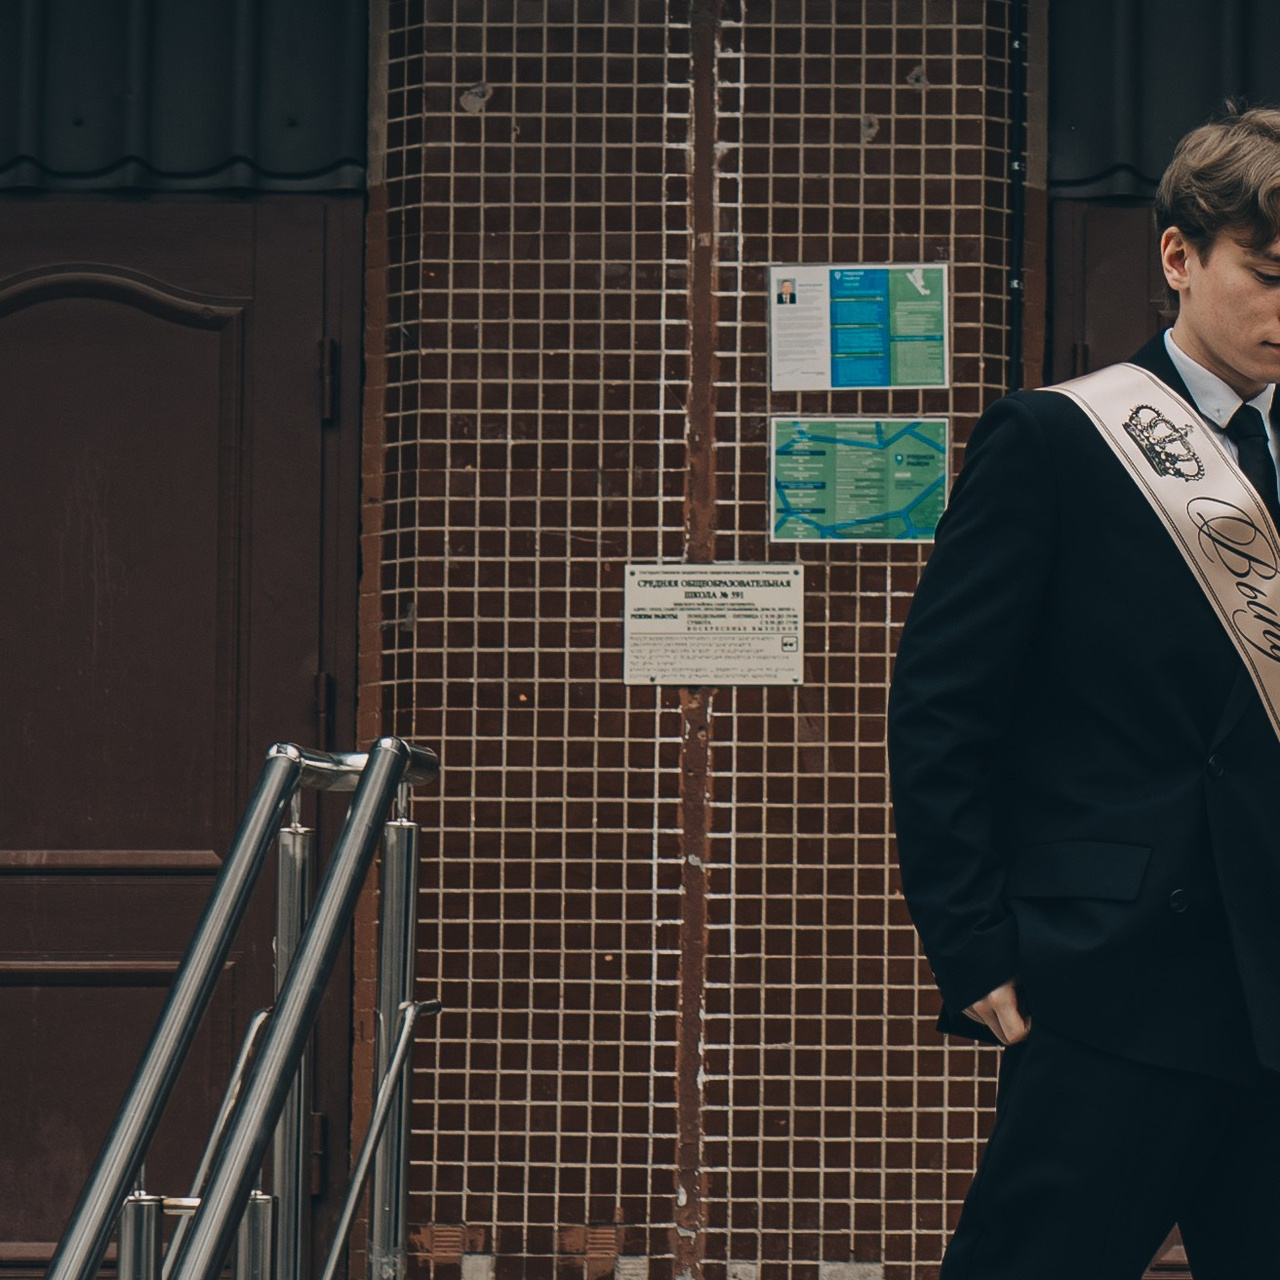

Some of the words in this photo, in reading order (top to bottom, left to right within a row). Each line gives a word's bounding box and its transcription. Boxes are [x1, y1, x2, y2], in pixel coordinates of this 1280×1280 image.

[637, 580, 679, 588] СРЕДНЯЯ
[681, 580, 791, 588] ОБЩЕОБРАЗОВАТЕЛЬНАЯ
[684, 591, 717, 600] ШКОЛА
[731, 591, 744, 600] 591
